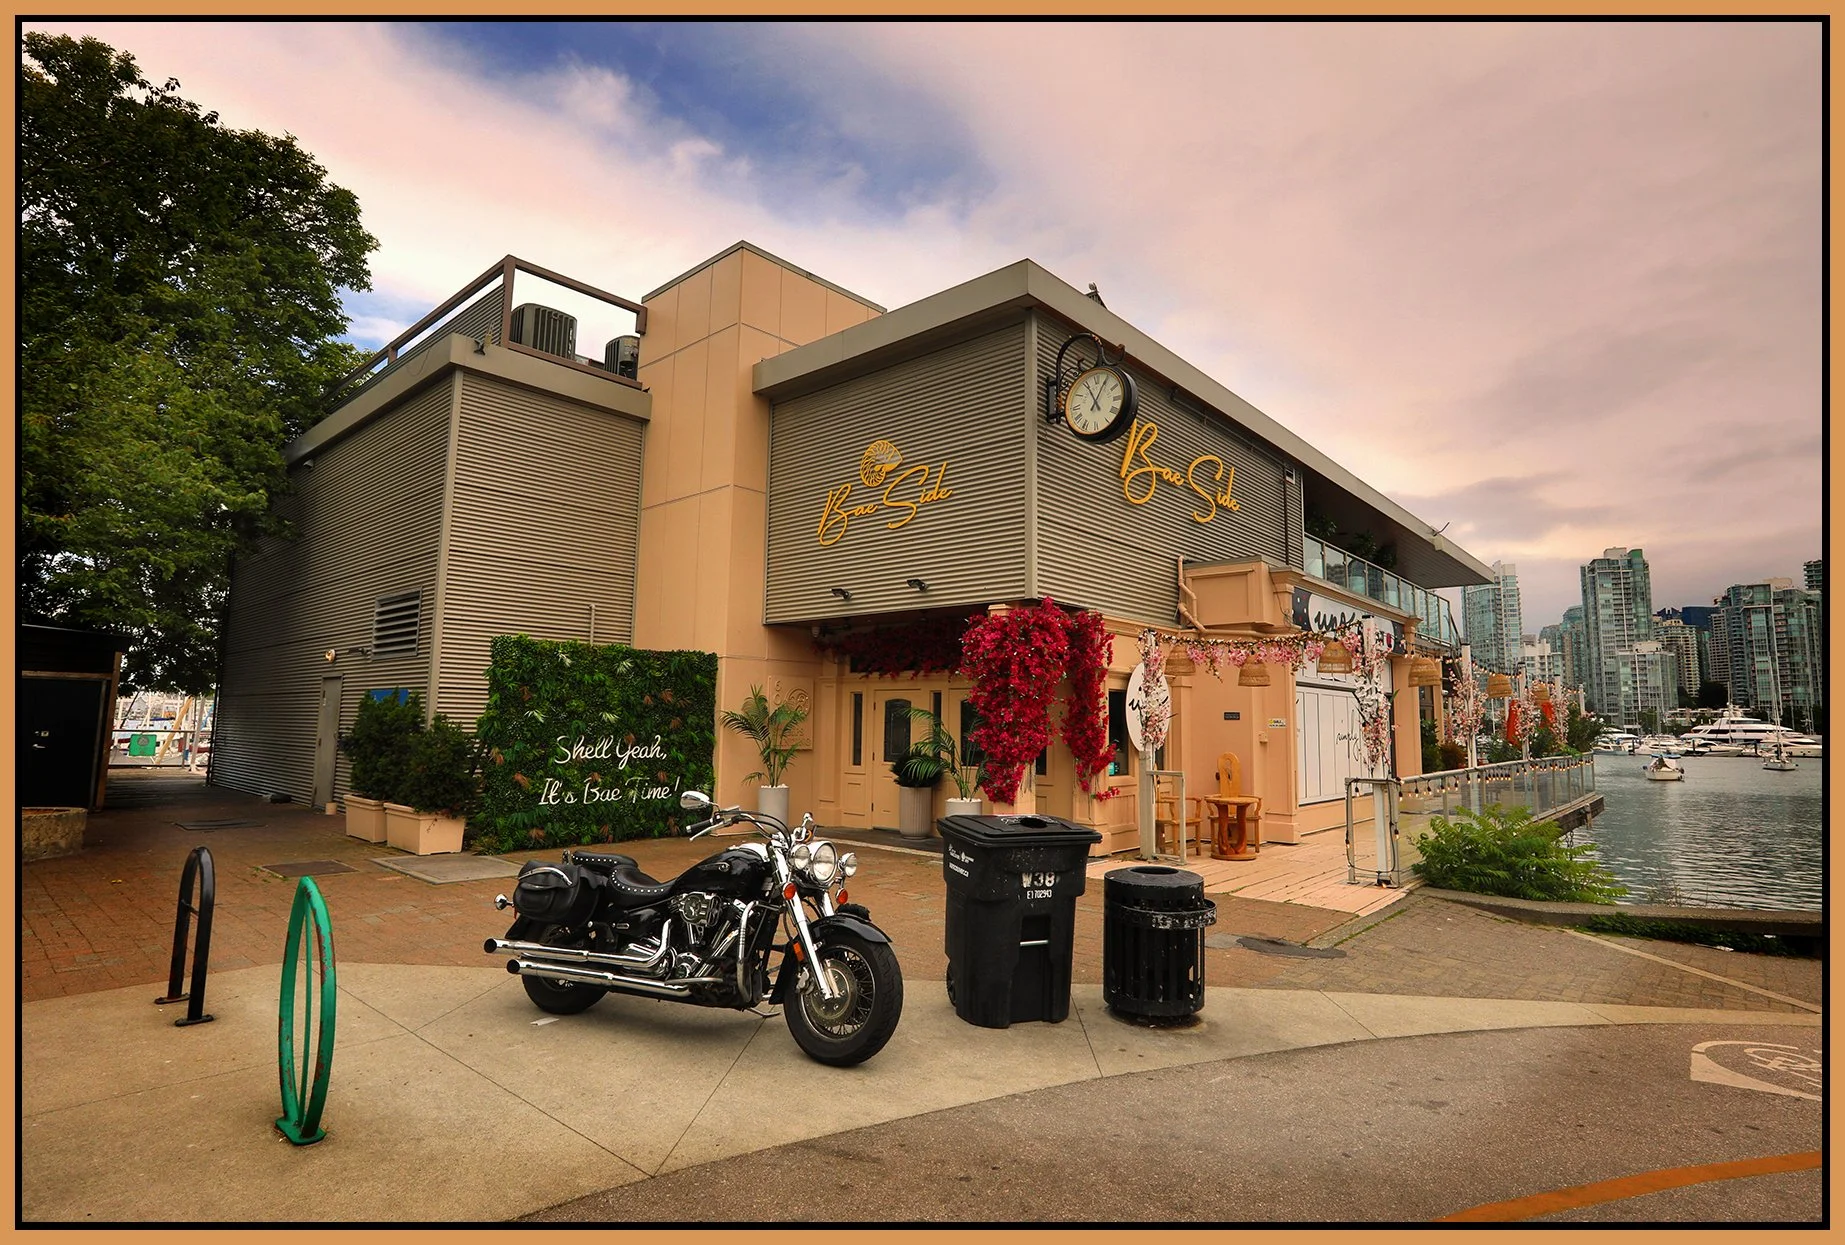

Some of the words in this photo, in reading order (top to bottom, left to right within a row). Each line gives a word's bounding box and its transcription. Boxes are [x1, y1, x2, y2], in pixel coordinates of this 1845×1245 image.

[1119, 418, 1185, 505] Bae
[1187, 455, 1240, 523] Side
[818, 483, 878, 546] Bae
[883, 461, 952, 529] Side
[554, 735, 614, 764] Shell
[616, 735, 668, 770] Yeah,
[538, 777, 577, 805] It's
[583, 777, 622, 805] Bae
[625, 776, 681, 804] Time!
[1022, 872, 1056, 888] W38
